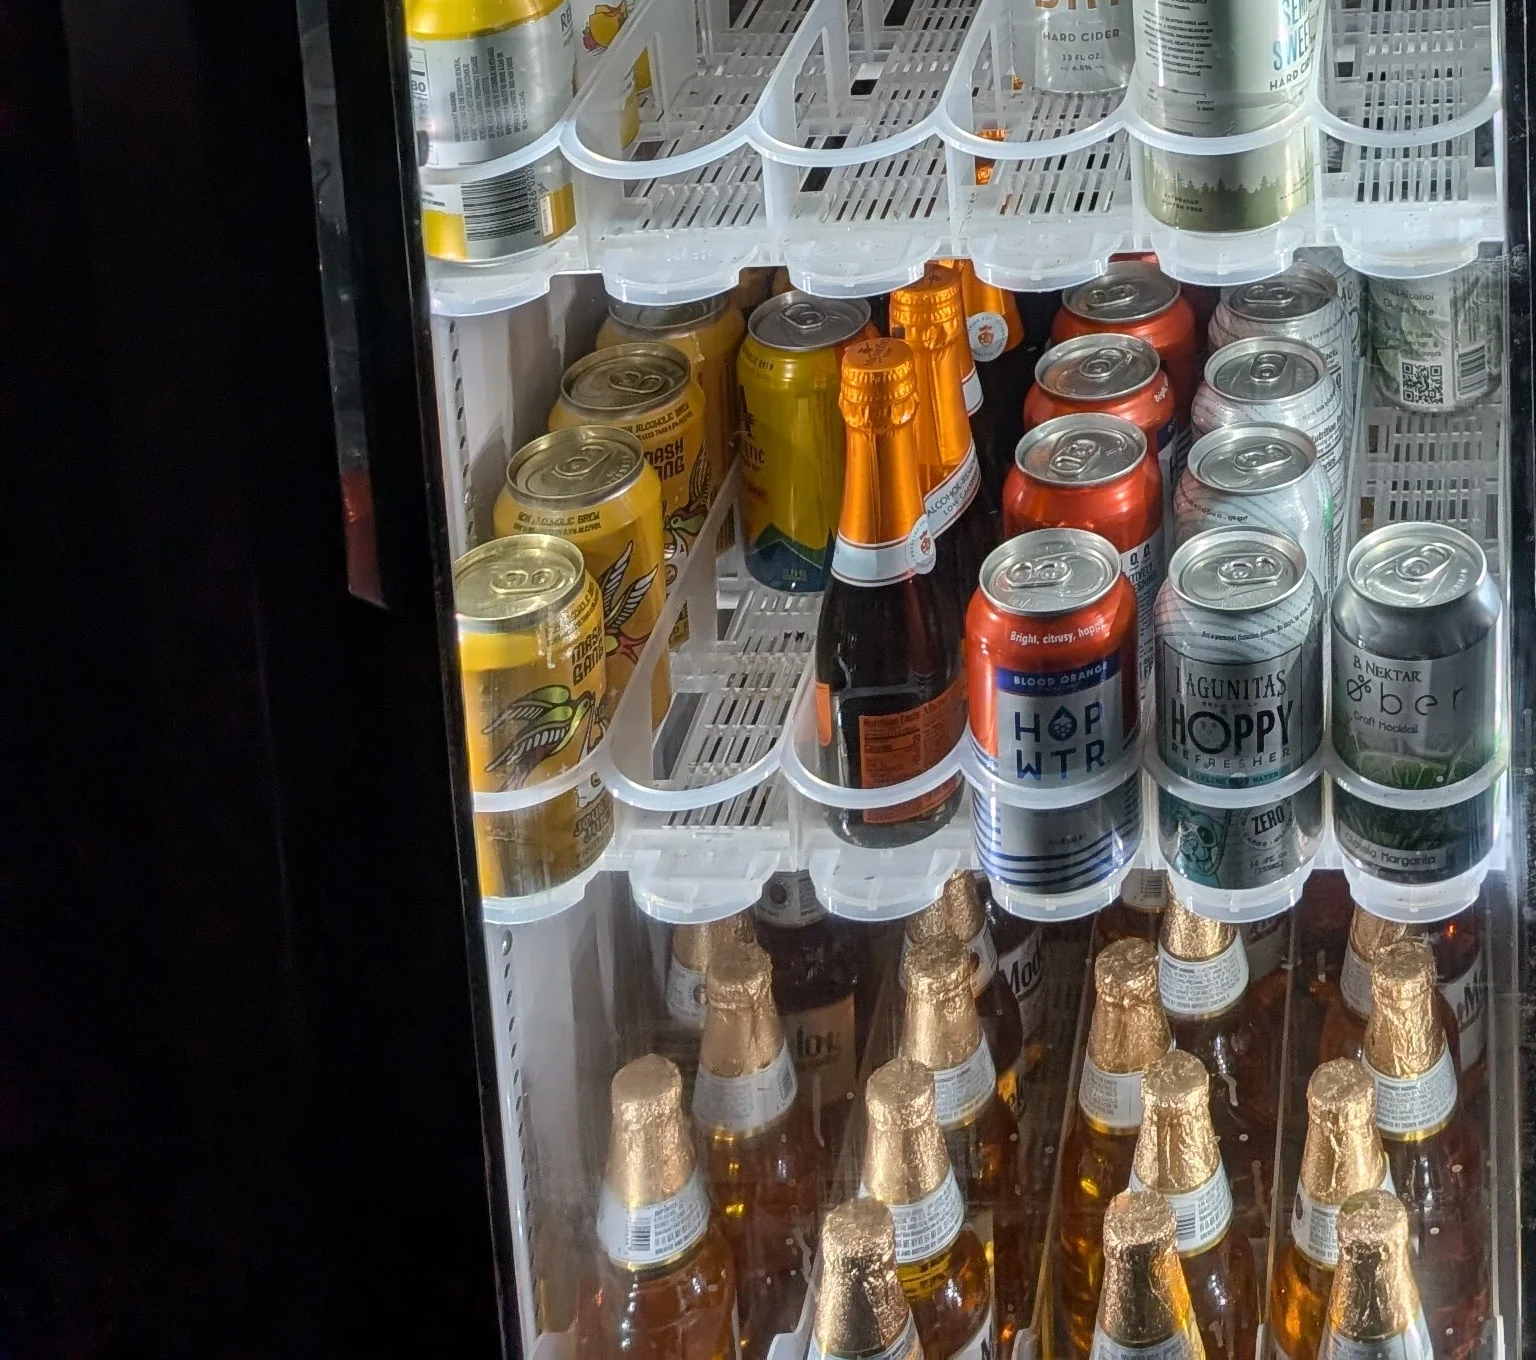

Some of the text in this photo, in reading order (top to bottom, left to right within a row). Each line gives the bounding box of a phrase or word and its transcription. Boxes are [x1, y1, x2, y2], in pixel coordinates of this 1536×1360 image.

[1043, 29, 1120, 42] HARD CIDER
[1075, 53, 1085, 61] FL
[1270, 69, 1299, 92] HARD
[578, 511, 600, 524] BREW
[1010, 631, 1076, 646] Bright, citrusy,
[1013, 661, 1107, 686] BLOOD ORANGE
[1366, 662, 1422, 682] NEKTAR
[1176, 667, 1287, 700] LAGUNITAS
[1171, 697, 1293, 757] HOPPY
[1353, 711, 1375, 728] Craft
[1016, 739, 1106, 781] WTR
[1172, 743, 1290, 769] REFRESHER
[1252, 805, 1284, 835] ZERO
[1381, 853, 1436, 868] Margarita
